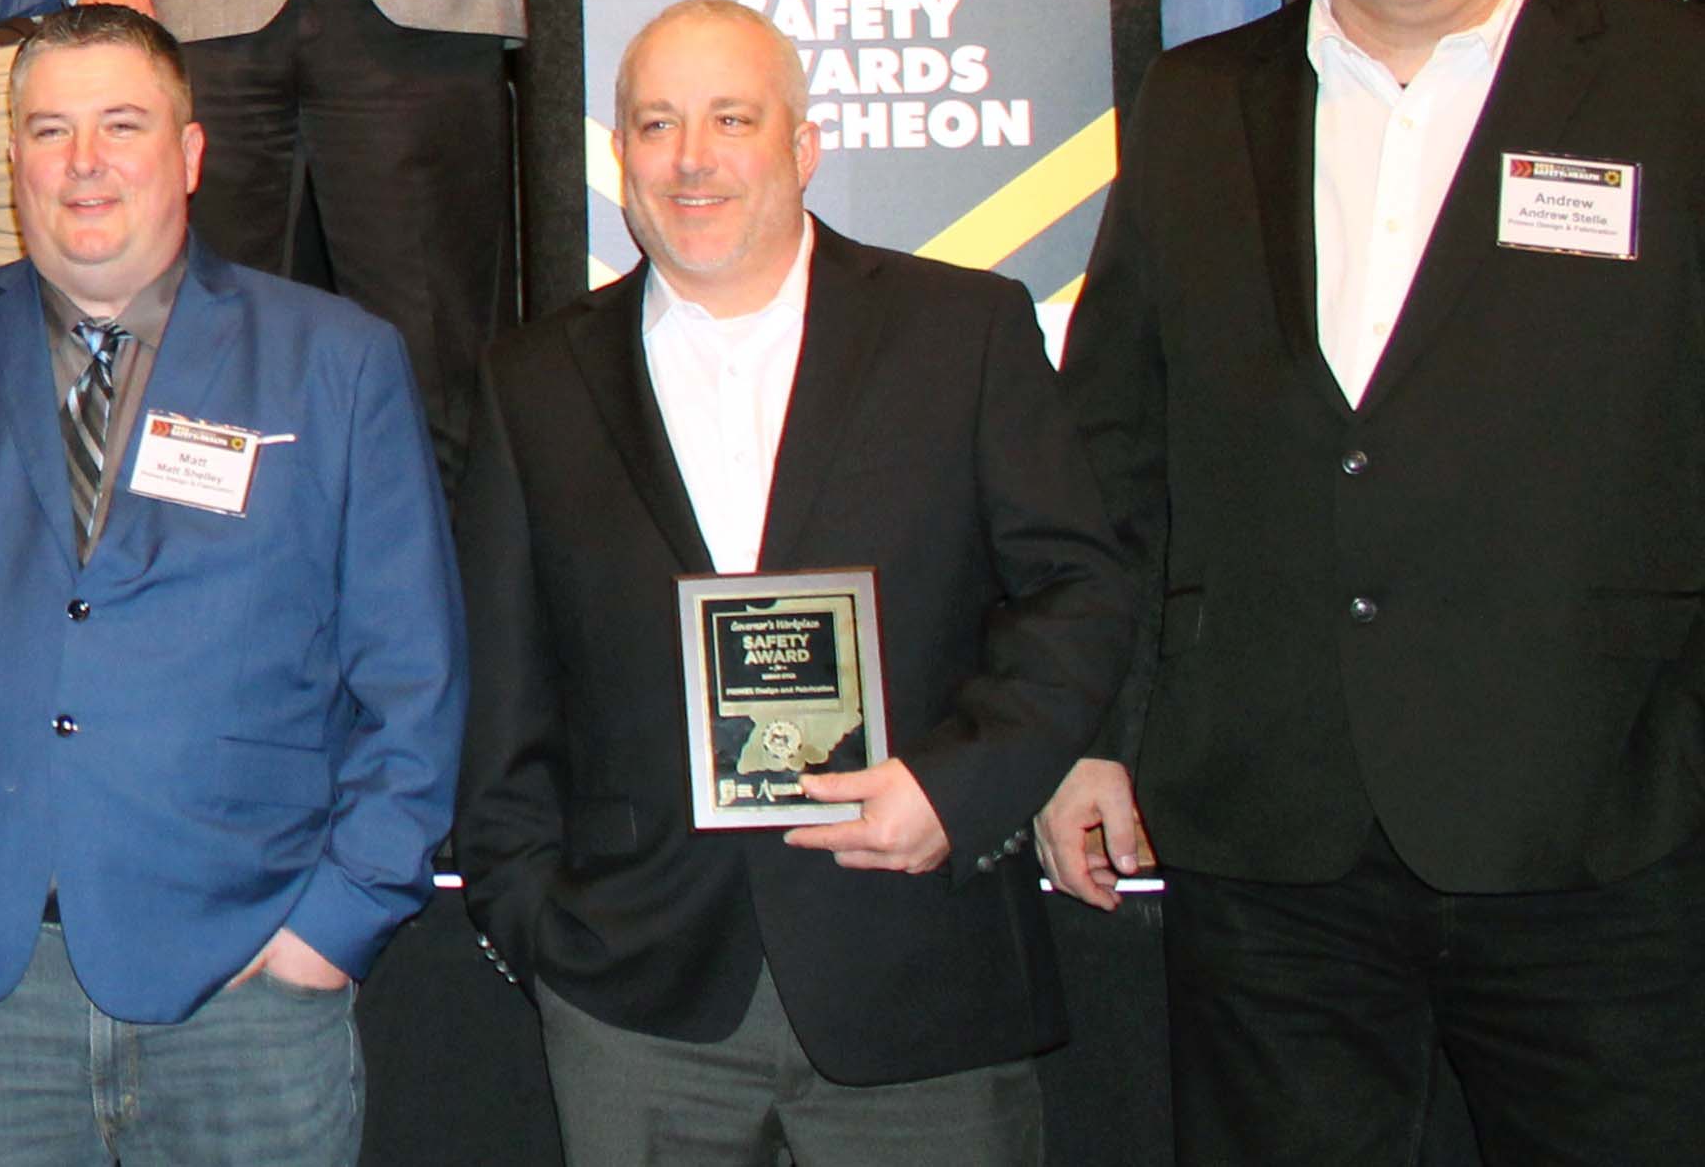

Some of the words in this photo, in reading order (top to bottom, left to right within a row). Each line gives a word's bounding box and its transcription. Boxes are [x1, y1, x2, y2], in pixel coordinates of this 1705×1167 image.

[797, 45, 989, 95] ARDS
[806, 98, 1032, 151] CHEON
[1535, 193, 1594, 209] Andrew
[1519, 207, 1568, 221] Andrew
[178, 453, 208, 468] Matt
[157, 463, 181, 476] Matt
[742, 633, 809, 650] SAFETY
[744, 649, 811, 665] AWARD
